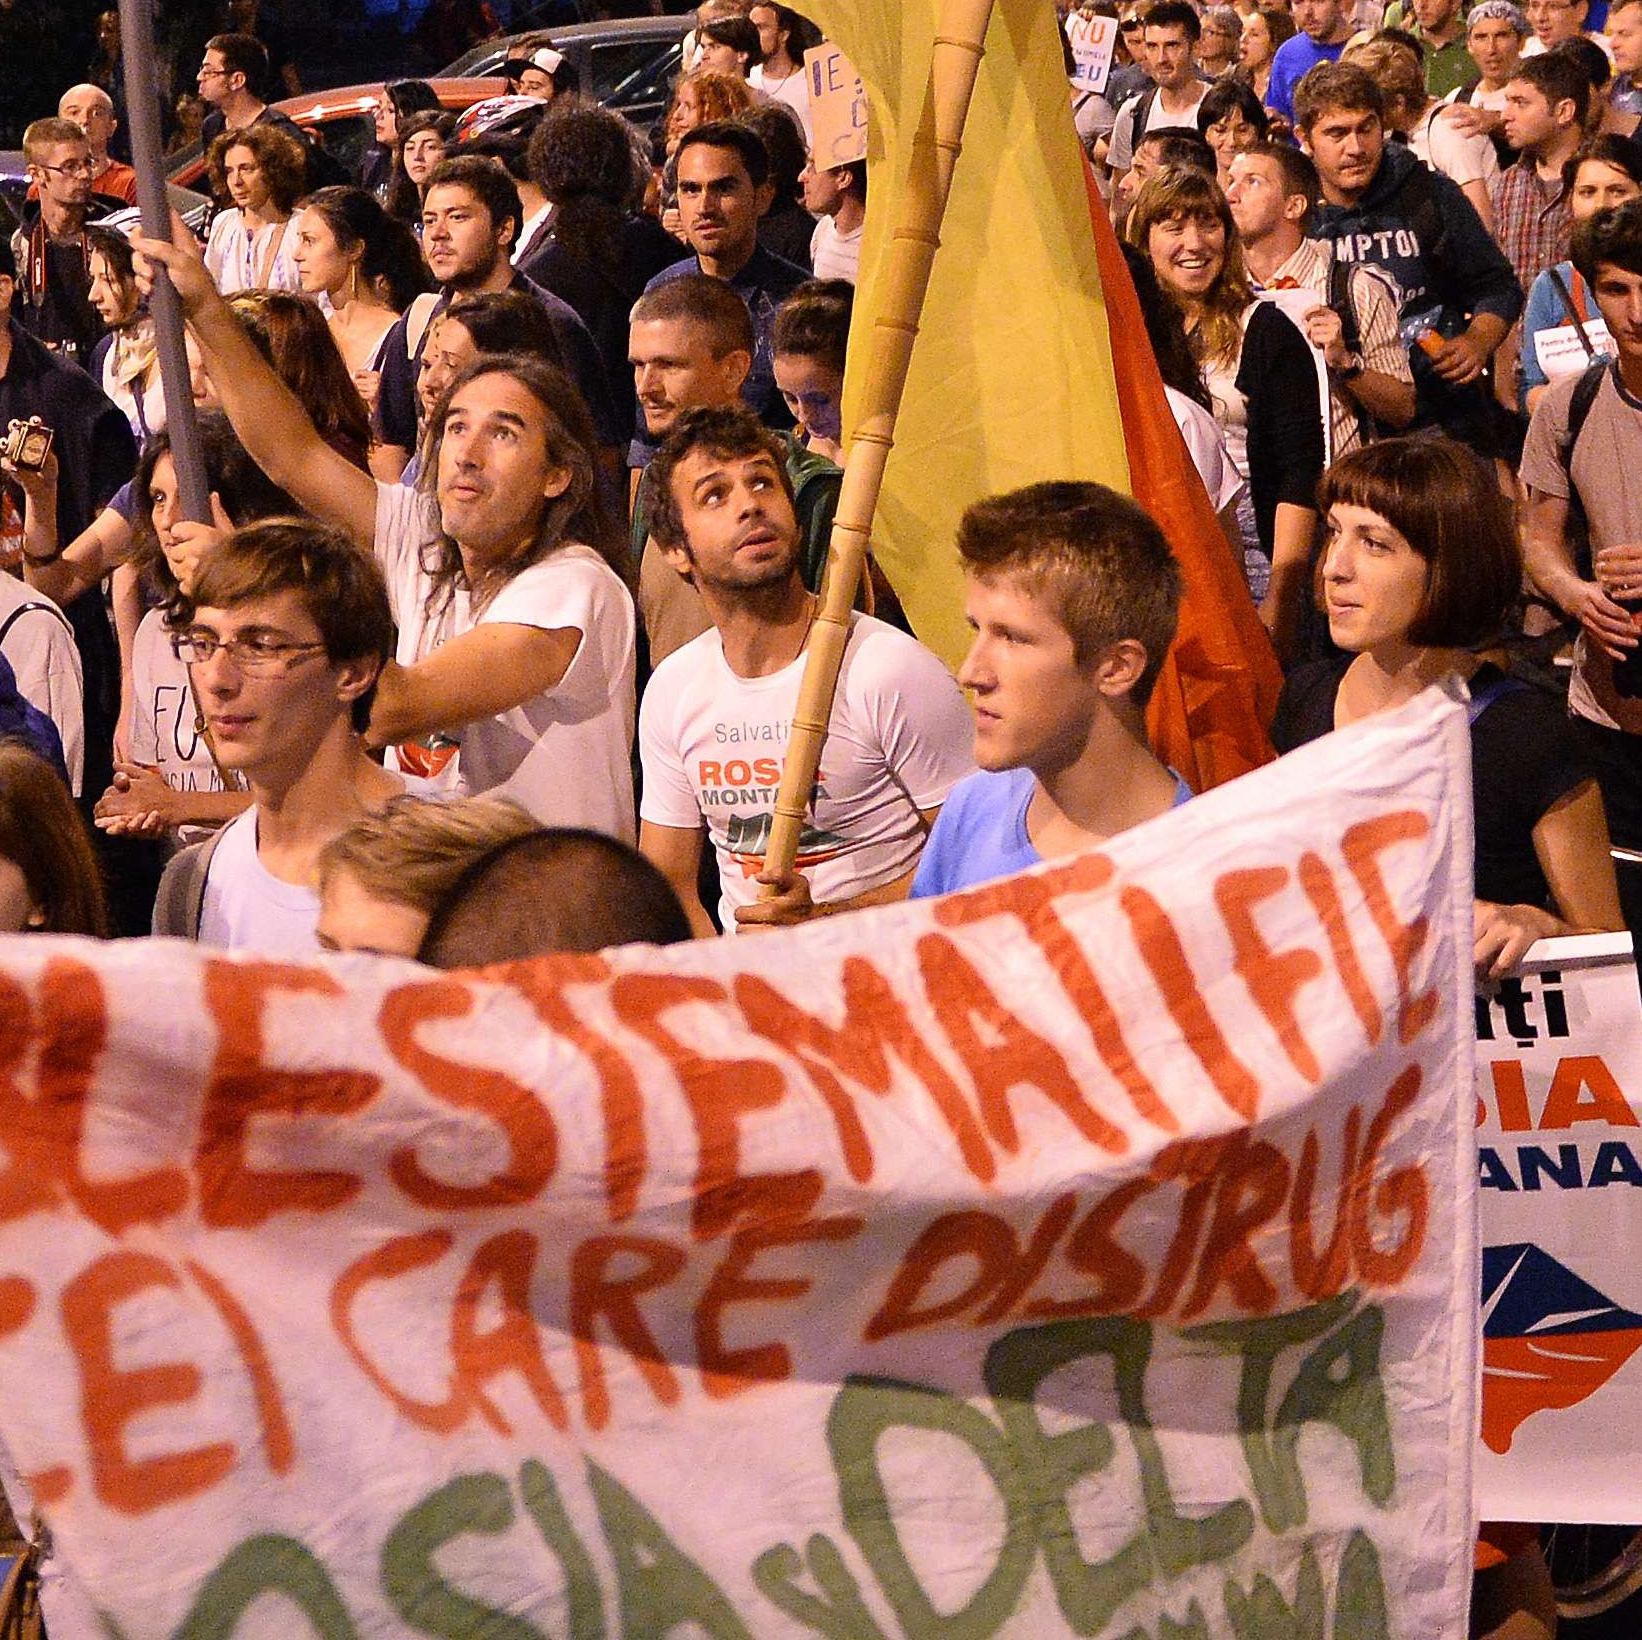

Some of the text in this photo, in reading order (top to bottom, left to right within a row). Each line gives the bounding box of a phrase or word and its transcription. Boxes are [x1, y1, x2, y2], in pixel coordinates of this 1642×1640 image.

[1069, 20, 1106, 45] NU
[153, 685, 199, 763] EU
[1475, 1055, 1641, 1132] IA
[328, 1214, 863, 1436] CARE
[863, 1062, 1430, 1344] DISTRUG
[825, 1286, 1397, 1640] DELTA
